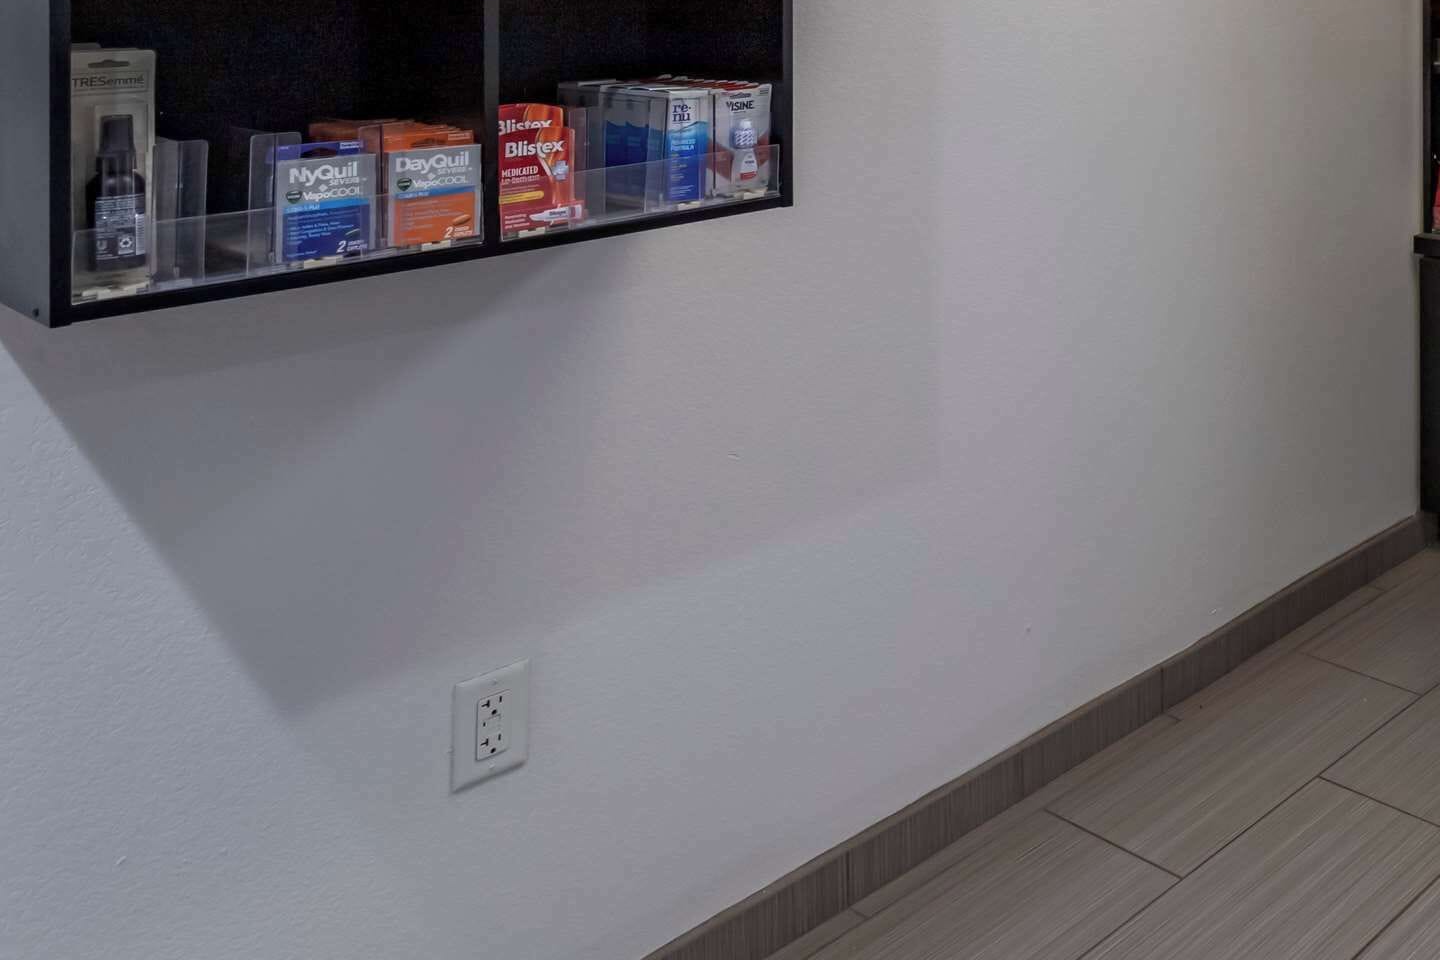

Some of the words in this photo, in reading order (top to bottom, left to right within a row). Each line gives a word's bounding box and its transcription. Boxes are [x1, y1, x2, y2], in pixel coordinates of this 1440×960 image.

[726, 100, 754, 111] VISINE
[505, 140, 565, 158] Blistex
[396, 152, 469, 174] DayQuil
[289, 161, 358, 187] NyQuil
[502, 166, 538, 177] MEDICATED
[444, 226, 453, 238] 2
[336, 240, 346, 253] 2
